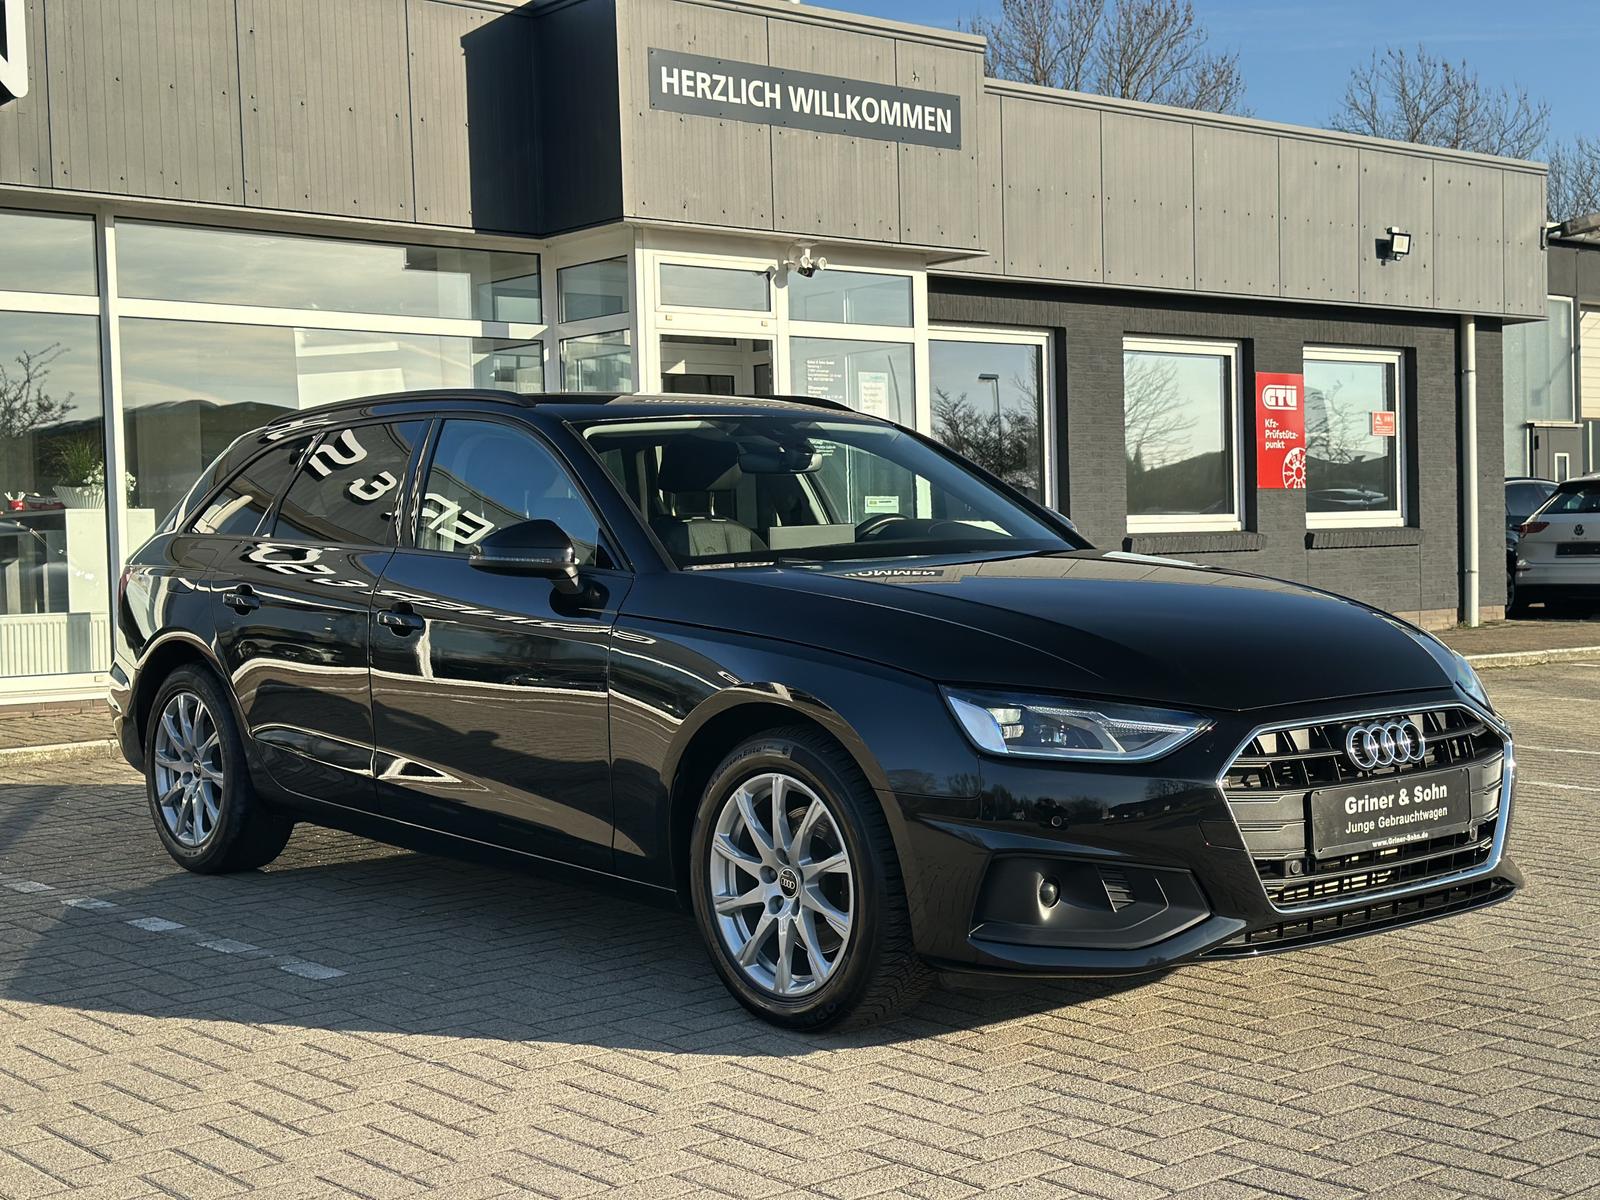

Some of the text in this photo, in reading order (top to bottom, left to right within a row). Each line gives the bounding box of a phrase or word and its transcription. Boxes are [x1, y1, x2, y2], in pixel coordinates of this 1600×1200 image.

[660, 66, 952, 133] HERZLICH WILLKOMMEN
[1264, 418, 1279, 428] Kfz-
[1265, 429, 1299, 440] Prüfstütz-
[1265, 440, 1285, 450] punkt
[1344, 783, 1448, 814] Griner & Sohn
[1345, 806, 1448, 834] Junge Gebrauchtwagen
[1372, 831, 1429, 848] www.Griner-Sohn.de
